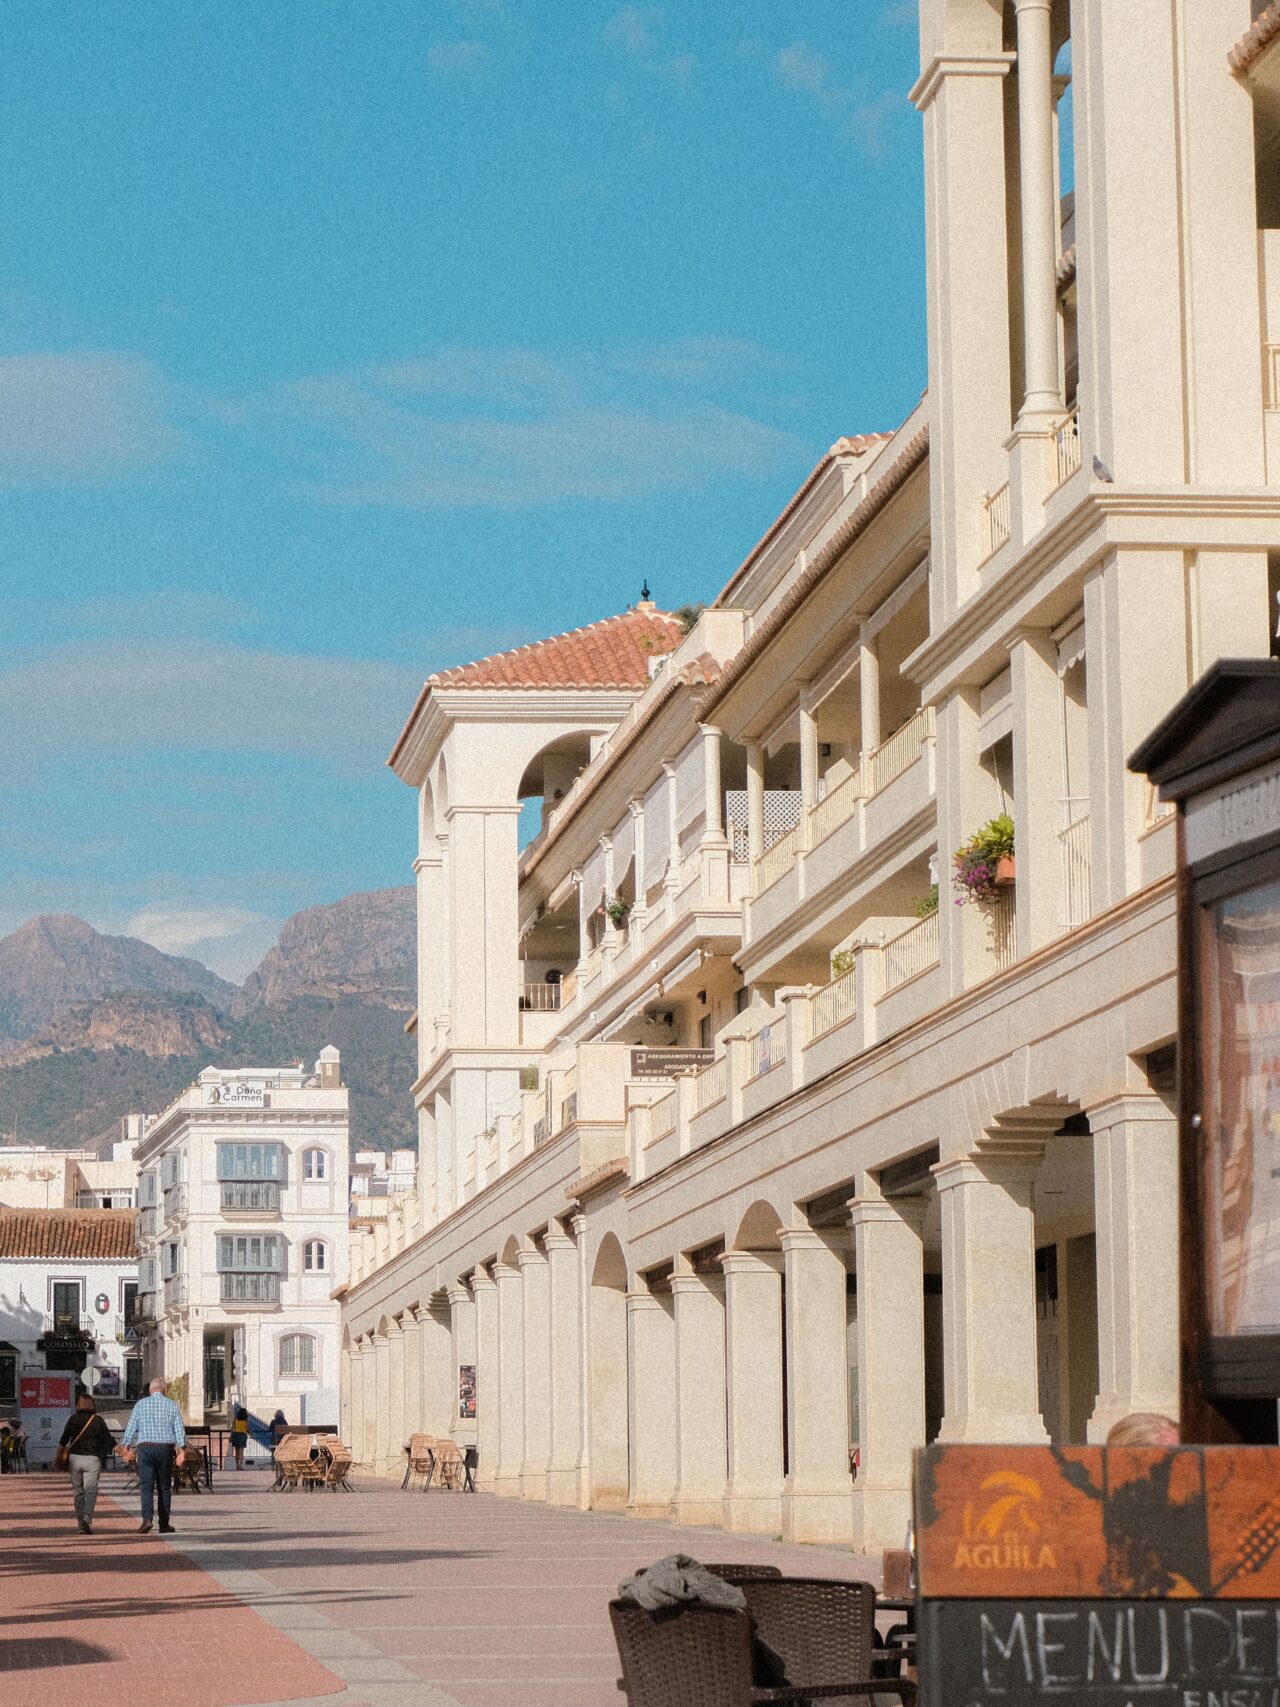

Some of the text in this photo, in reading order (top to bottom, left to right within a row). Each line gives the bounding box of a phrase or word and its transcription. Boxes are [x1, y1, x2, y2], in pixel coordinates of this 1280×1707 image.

[223, 1093, 262, 1102] Carmen
[980, 1607, 1280, 1687] MENU DE
